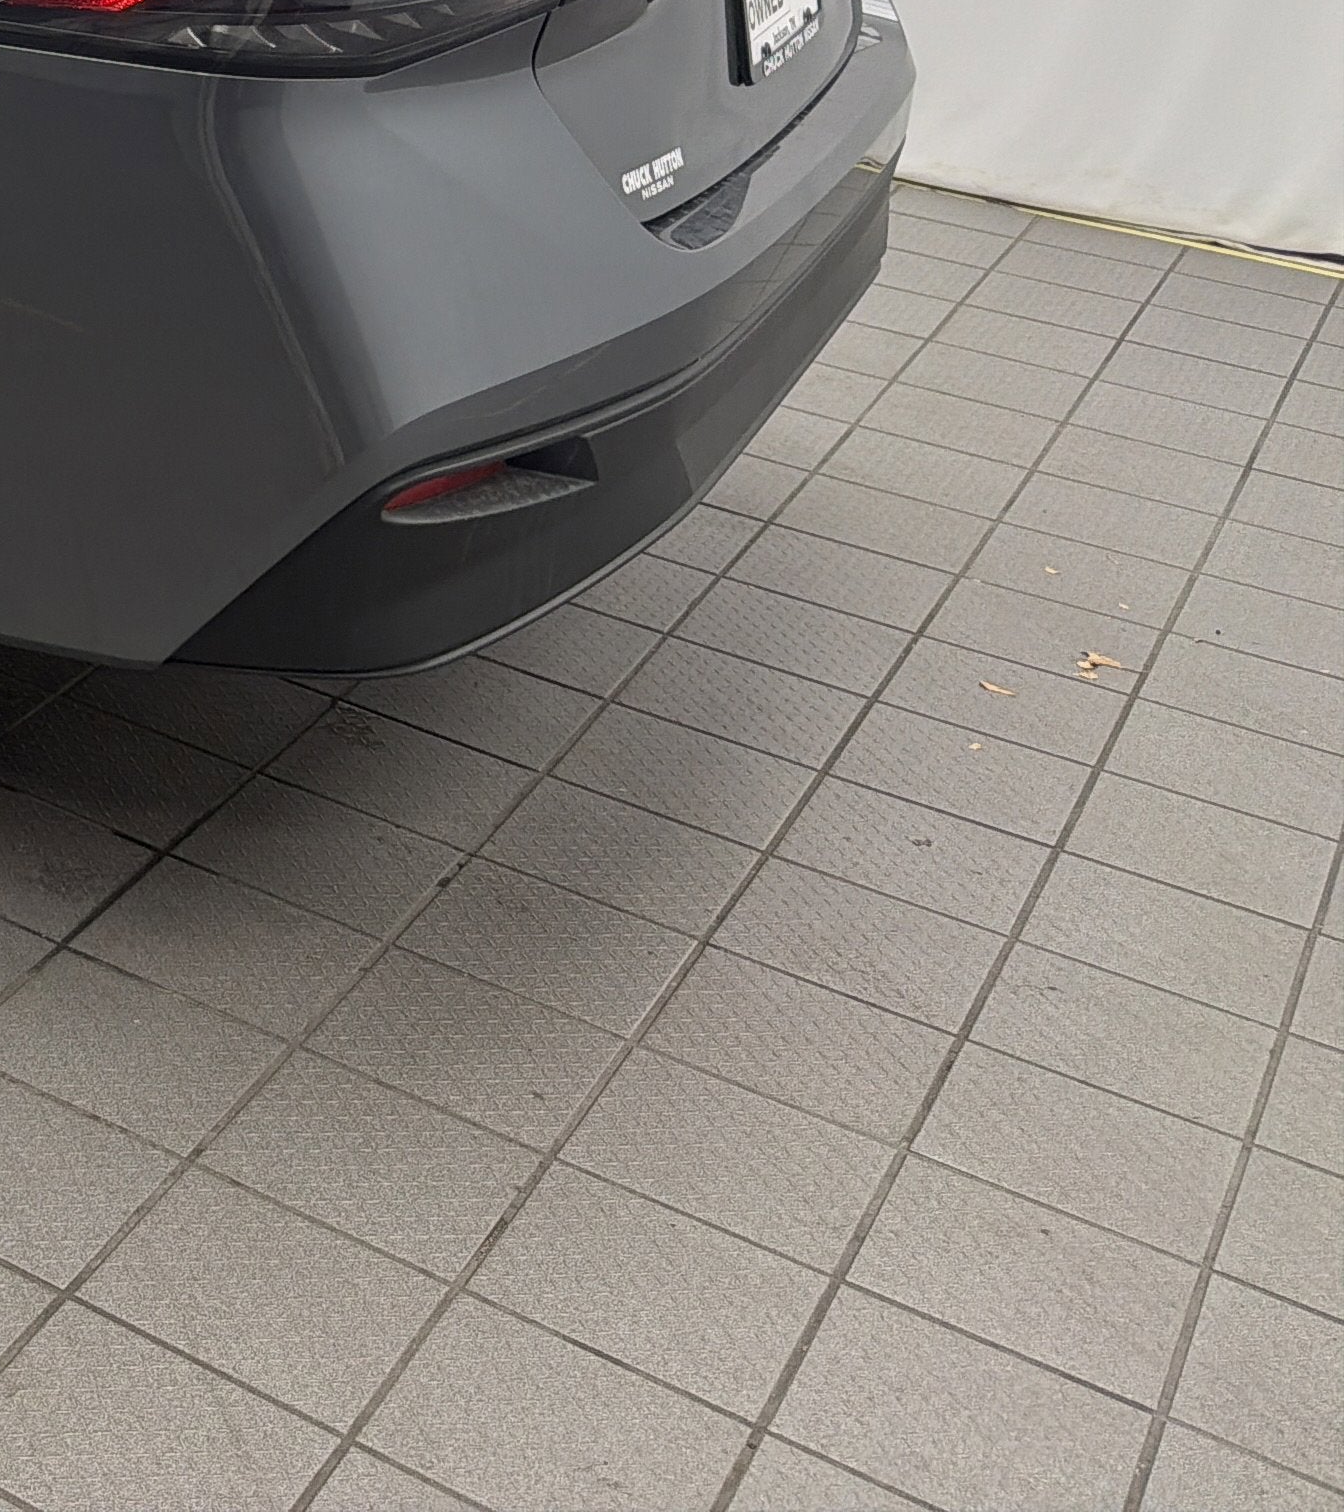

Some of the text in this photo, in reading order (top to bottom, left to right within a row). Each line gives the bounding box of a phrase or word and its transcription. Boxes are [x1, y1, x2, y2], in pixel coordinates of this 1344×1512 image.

[622, 146, 684, 195] CHUCK HUTTON
[641, 174, 674, 201] NISSAN
